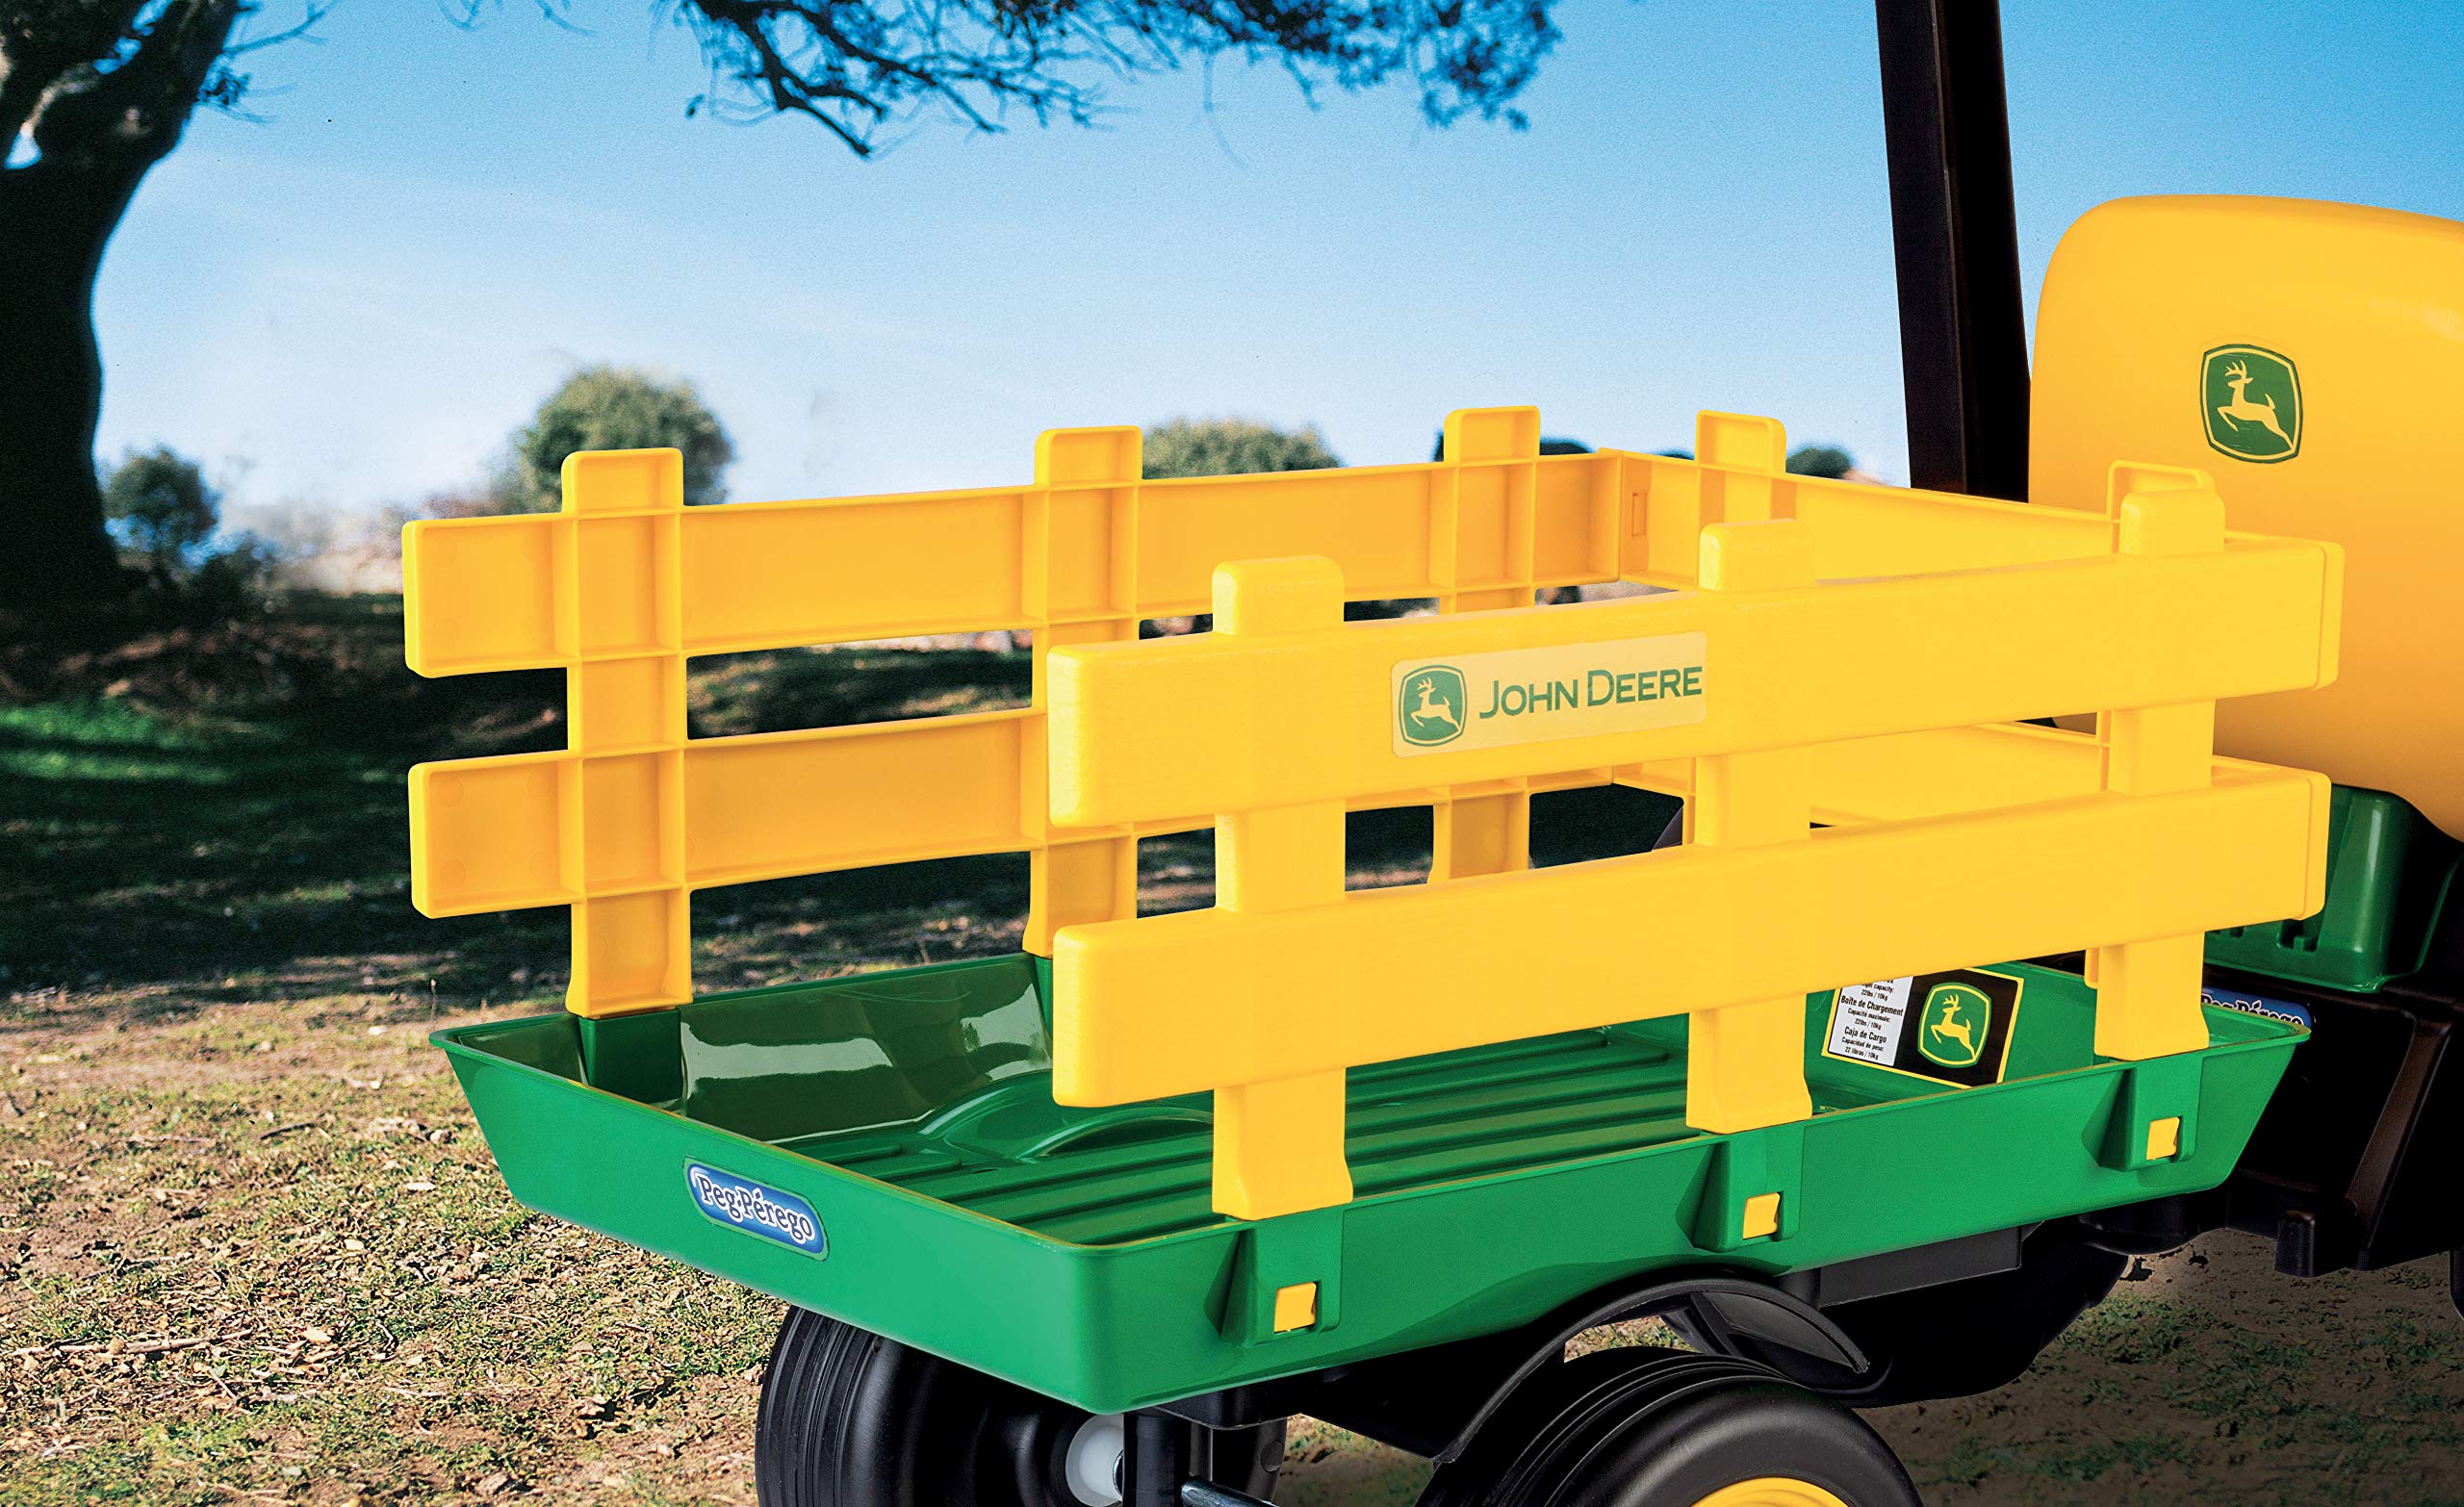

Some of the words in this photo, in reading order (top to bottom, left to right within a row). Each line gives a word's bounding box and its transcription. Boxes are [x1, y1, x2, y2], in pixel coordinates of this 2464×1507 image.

[1479, 679, 1578, 719] JOHN
[1587, 666, 1703, 707] DEERE
[1841, 995, 1857, 1006] Boîte
[1867, 1001, 1903, 1016] Chargement
[1842, 1037, 1864, 1047] Capacidad
[1845, 1027, 1858, 1037] Caja
[1869, 1033, 1886, 1043] Cargo
